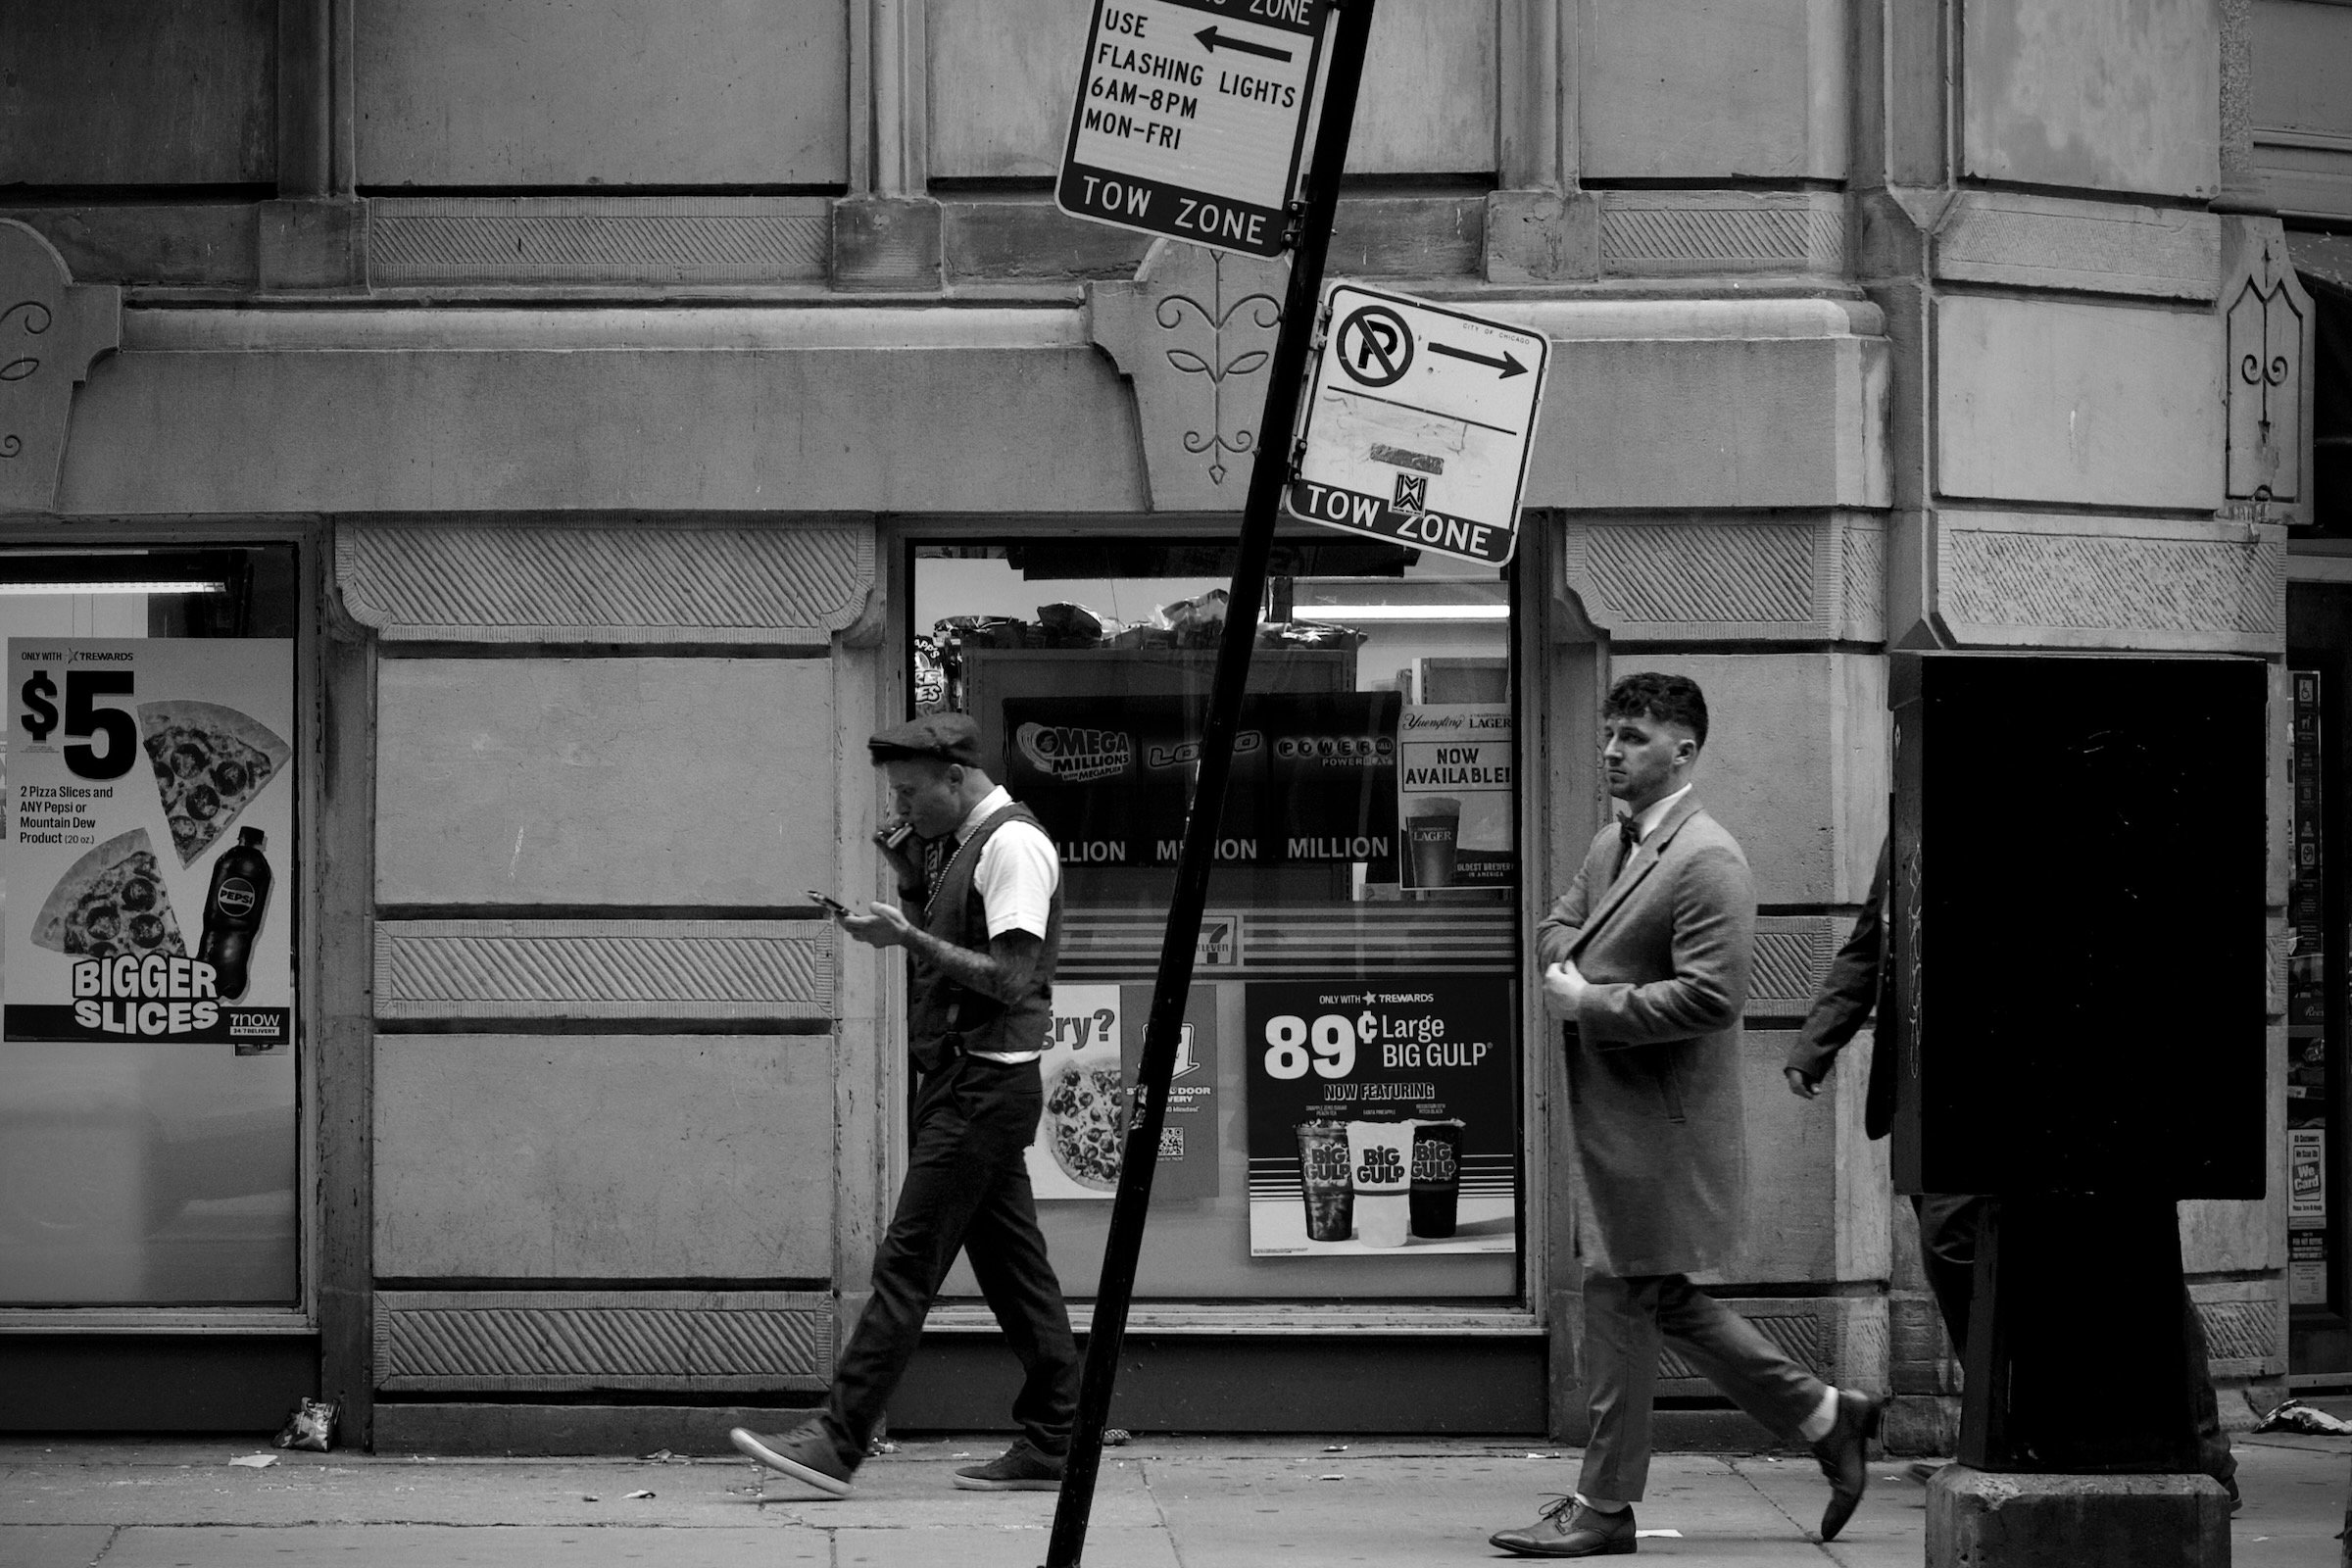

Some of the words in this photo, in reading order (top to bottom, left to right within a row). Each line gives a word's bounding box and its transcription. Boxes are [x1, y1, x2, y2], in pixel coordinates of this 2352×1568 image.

[1105, 8, 1149, 38] USE
[1098, 43, 1204, 86] FLASHING
[1219, 71, 1297, 108] LIGHTS
[1091, 76, 1198, 119] 6AM-8PM
[1085, 108, 1182, 150] MON-FRI
[1082, 174, 1152, 218] TOW
[1174, 197, 1267, 245] ZONE
[1462, 322, 1479, 332] CITY
[1498, 331, 1530, 345] CHICAGO
[1306, 484, 1380, 527] TOW
[1396, 514, 1492, 556] ZONE
[22, 652, 40, 661] ONLY
[42, 652, 62, 661] WITH
[79, 652, 134, 661] 7REWARDS
[21, 670, 137, 780] $5
[1402, 713, 1464, 730] Yuengling
[1470, 718, 1512, 728] LAGER
[1150, 732, 1260, 767] LOO
[1437, 748, 1480, 764] NOW
[1053, 754, 1128, 773] MILLIONS
[1405, 766, 1510, 784] AVAILABLE!
[21, 786, 27, 798] 2
[29, 785, 57, 798] Pizza
[59, 785, 91, 798] Slices
[93, 785, 113, 798] and
[20, 802, 42, 813] ANY
[44, 801, 73, 815] Pepsi
[75, 805, 86, 813] or
[21, 816, 70, 829] Mountain
[73, 817, 96, 829] Dew
[20, 832, 63, 844] Product
[65, 834, 78, 845] (20
[80, 834, 95, 845] oz.)
[1413, 831, 1451, 841] LAGER
[1056, 841, 1126, 861] LLION
[1288, 836, 1389, 858] MILLION
[1457, 862, 1482, 871] OLDEST
[220, 889, 254, 905] PEPSI
[74, 954, 219, 999] BIGGER
[1319, 995, 1339, 1004] ONLY
[1341, 995, 1361, 1004] WITH
[1379, 994, 1434, 1003] 7REWARDS
[74, 1001, 220, 1035] SLICES
[1382, 1014, 1445, 1043] Large
[1383, 1044, 1421, 1067] BIG
[1324, 1084, 1358, 1101] NOW
[1360, 1083, 1435, 1100] FEATURING
[1305, 1164, 1350, 1181] GULP
[1357, 1165, 1405, 1184] GULP
[1411, 1159, 1456, 1179] GULP
[2297, 1165, 2315, 1178] We
[2294, 1175, 2319, 1191] Card
